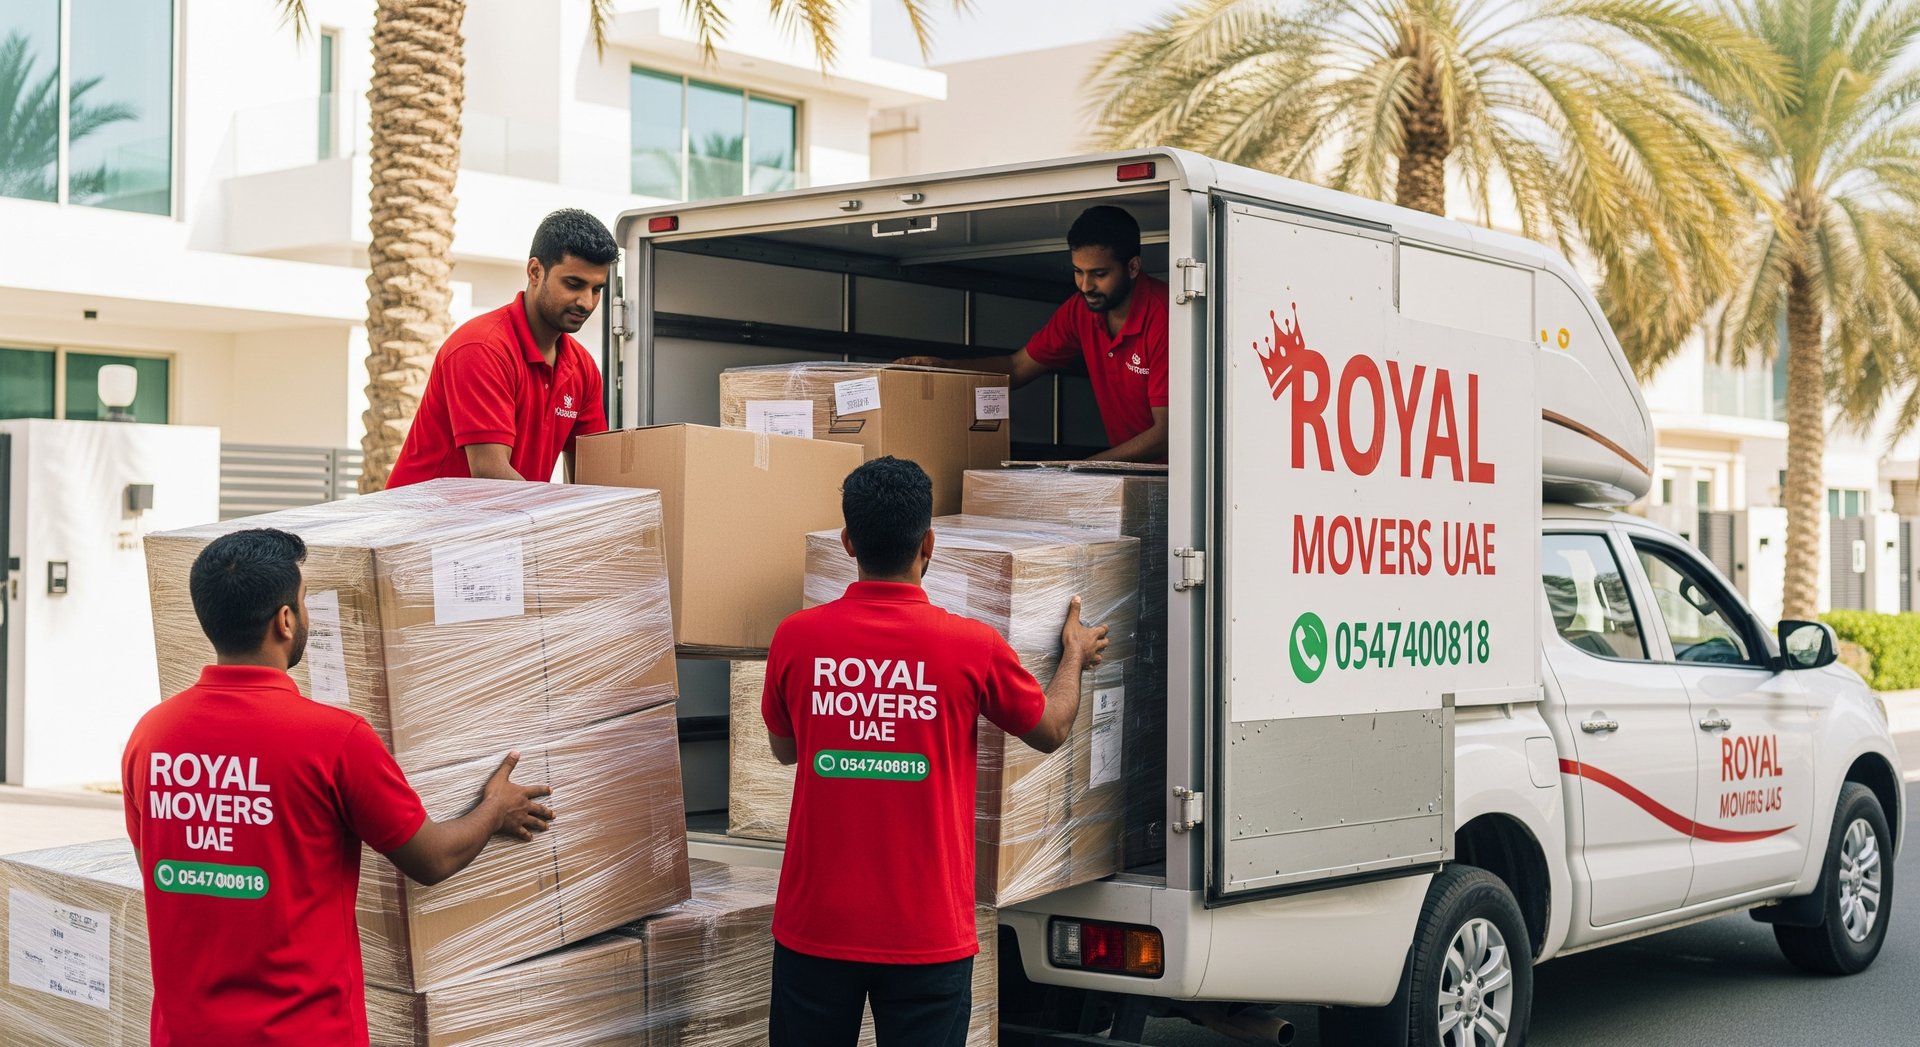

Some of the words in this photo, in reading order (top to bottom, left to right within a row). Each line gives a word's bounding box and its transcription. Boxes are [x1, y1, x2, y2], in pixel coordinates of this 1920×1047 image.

[1291, 349, 1495, 484] ROYAL
[1292, 514, 1433, 576] MOVERS
[1443, 520, 1496, 576] UAE
[1335, 619, 1490, 670] 0547400818
[813, 657, 938, 692] ROYAL
[811, 691, 938, 720] MOVERS
[849, 720, 896, 742] UAE
[150, 752, 271, 792] ROYAL
[1721, 734, 1783, 782] ROYAL
[150, 790, 274, 826] MOVERS
[185, 825, 234, 852] UAE
